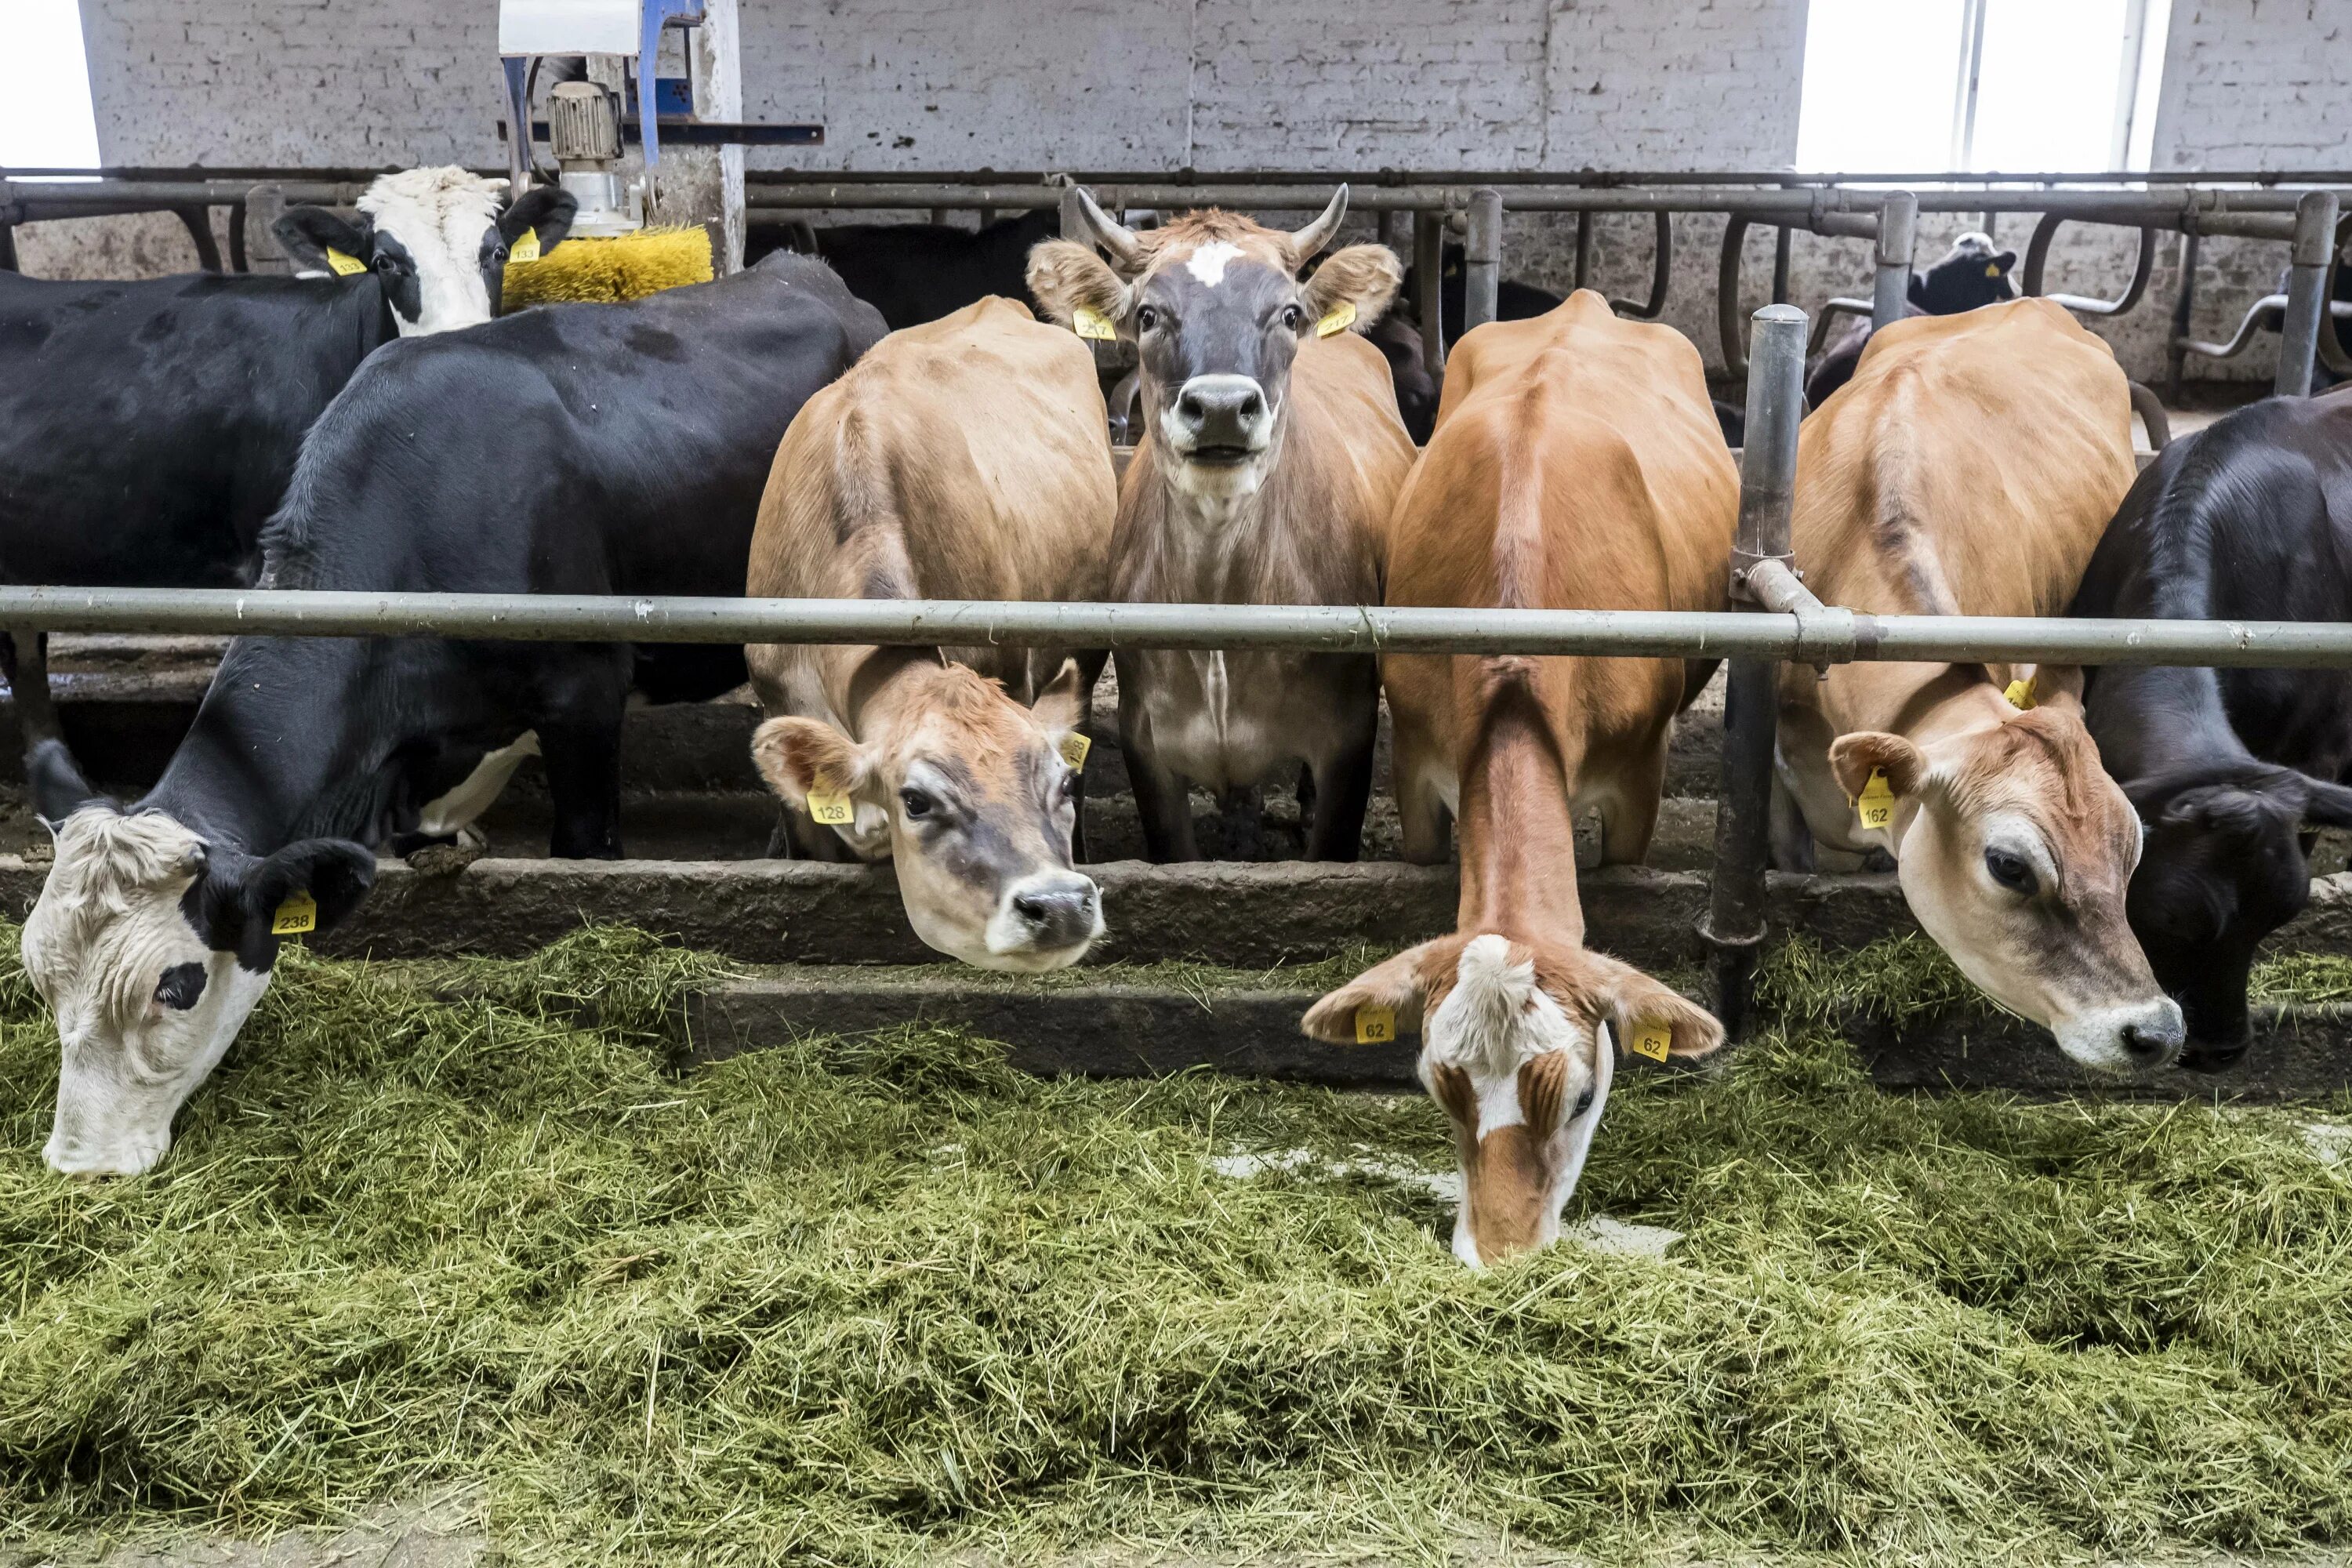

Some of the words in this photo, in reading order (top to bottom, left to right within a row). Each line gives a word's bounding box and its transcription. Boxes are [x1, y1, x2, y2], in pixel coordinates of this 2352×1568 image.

[516, 250, 534, 259] 133
[817, 806, 845, 819] 128
[1866, 808, 1888, 823] 162
[279, 914, 310, 930] 238
[1366, 1022, 1385, 1037] 62
[1643, 1037, 1661, 1055] 62
